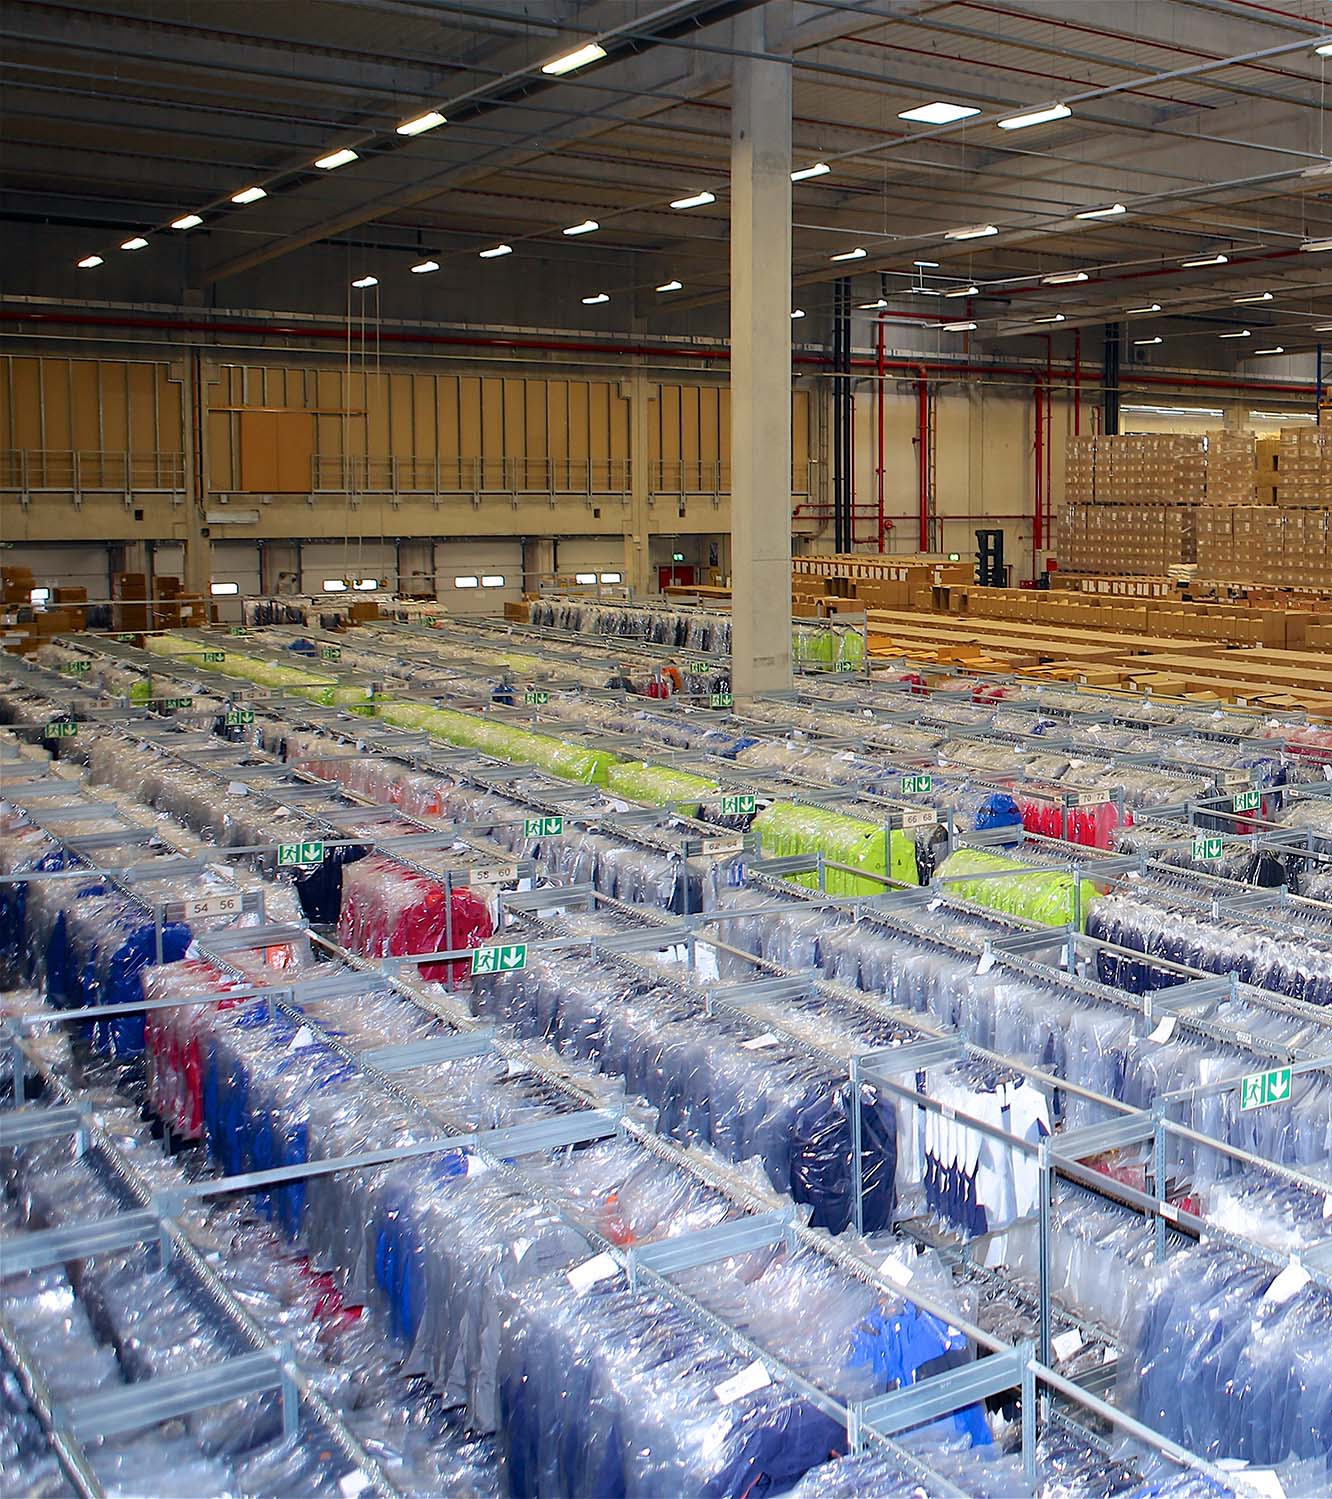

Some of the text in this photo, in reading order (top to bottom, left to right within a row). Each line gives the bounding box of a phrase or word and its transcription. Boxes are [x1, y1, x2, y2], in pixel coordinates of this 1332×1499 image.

[1083, 792, 1105, 803] 70 72
[907, 813, 933, 824] 66 68
[709, 842, 720, 851] 62
[477, 867, 511, 880] 58 60
[194, 899, 234, 914] 54 56
